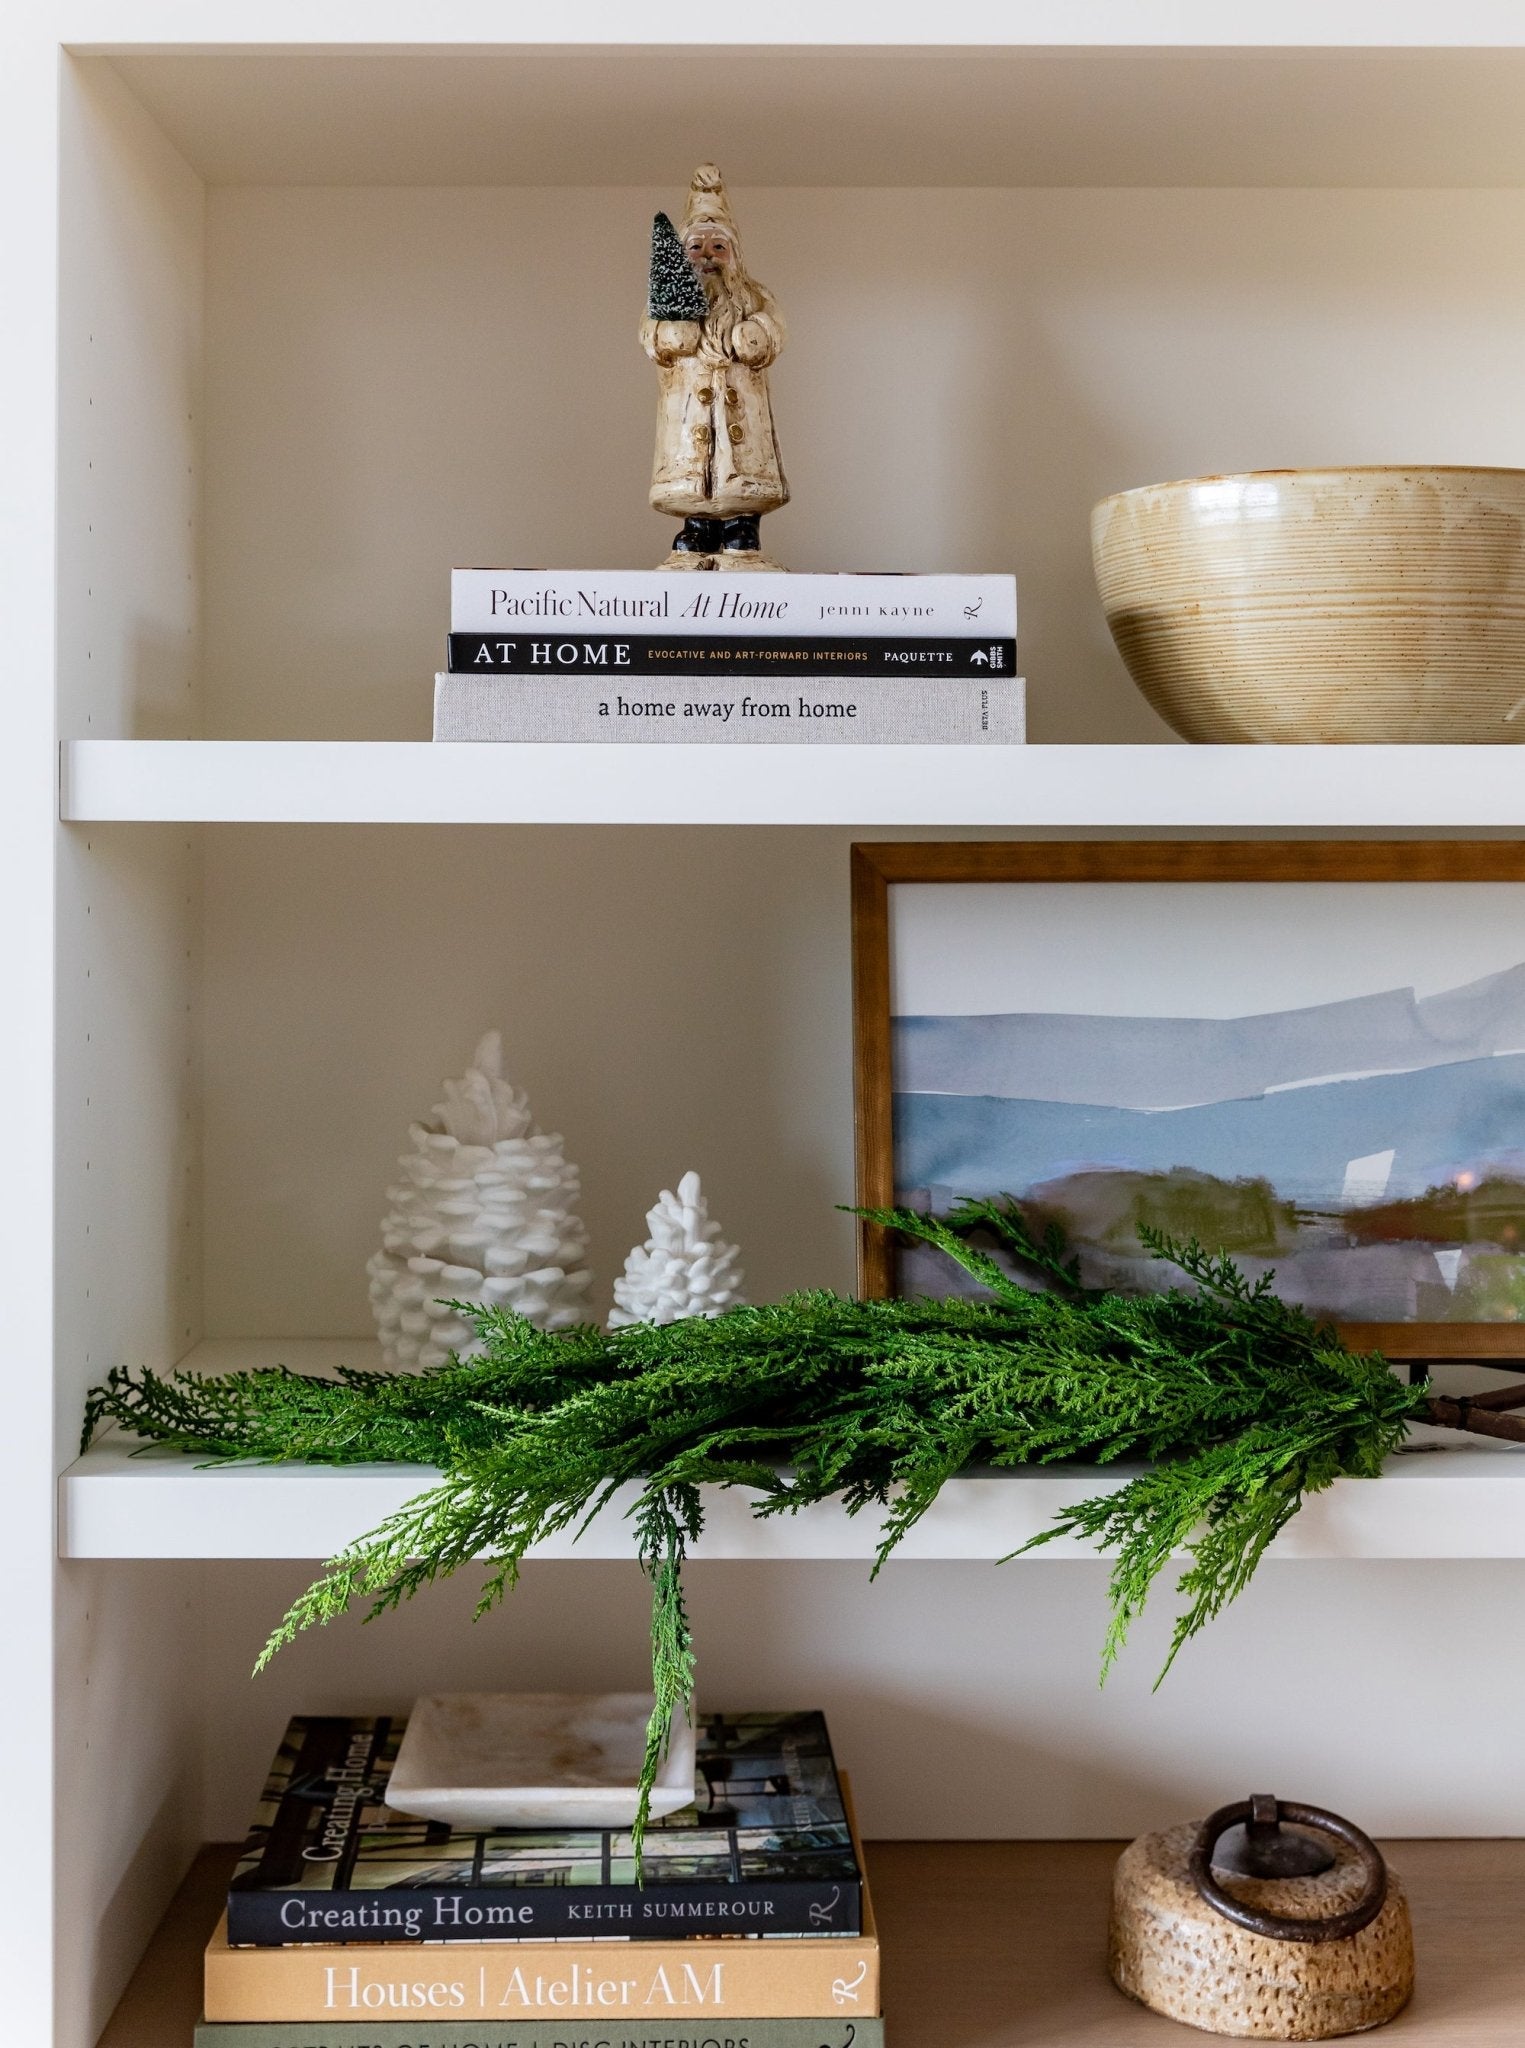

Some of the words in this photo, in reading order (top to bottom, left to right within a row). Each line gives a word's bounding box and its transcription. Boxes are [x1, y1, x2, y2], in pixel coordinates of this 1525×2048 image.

[490, 589, 572, 616] Pacific
[577, 590, 669, 617] Natural
[680, 592, 711, 617] At
[717, 592, 788, 619] Home
[473, 642, 517, 664] AT
[530, 643, 631, 665] HOME
[648, 650, 706, 659] EVOCATIVE
[709, 650, 731, 660] AND
[735, 651, 809, 661] ART-FORWARD
[813, 652, 868, 661] INTERIORS
[884, 652, 953, 664] PAQUETTE
[989, 646, 997, 669] GIBBS
[598, 702, 610, 717] a
[617, 697, 676, 717] home
[683, 703, 735, 723] away
[741, 697, 791, 718] from
[798, 697, 857, 718] home
[324, 1733, 374, 1782] Home
[302, 1783, 374, 1861] Creating
[280, 1898, 423, 1937] Creating
[432, 1896, 534, 1926] Home
[568, 1904, 632, 1919] KEITH
[643, 1900, 775, 1918] SUMMEROUR
[323, 1967, 465, 2008] Houses
[498, 1963, 637, 2007] Atelier
[643, 1963, 725, 2005] AM
